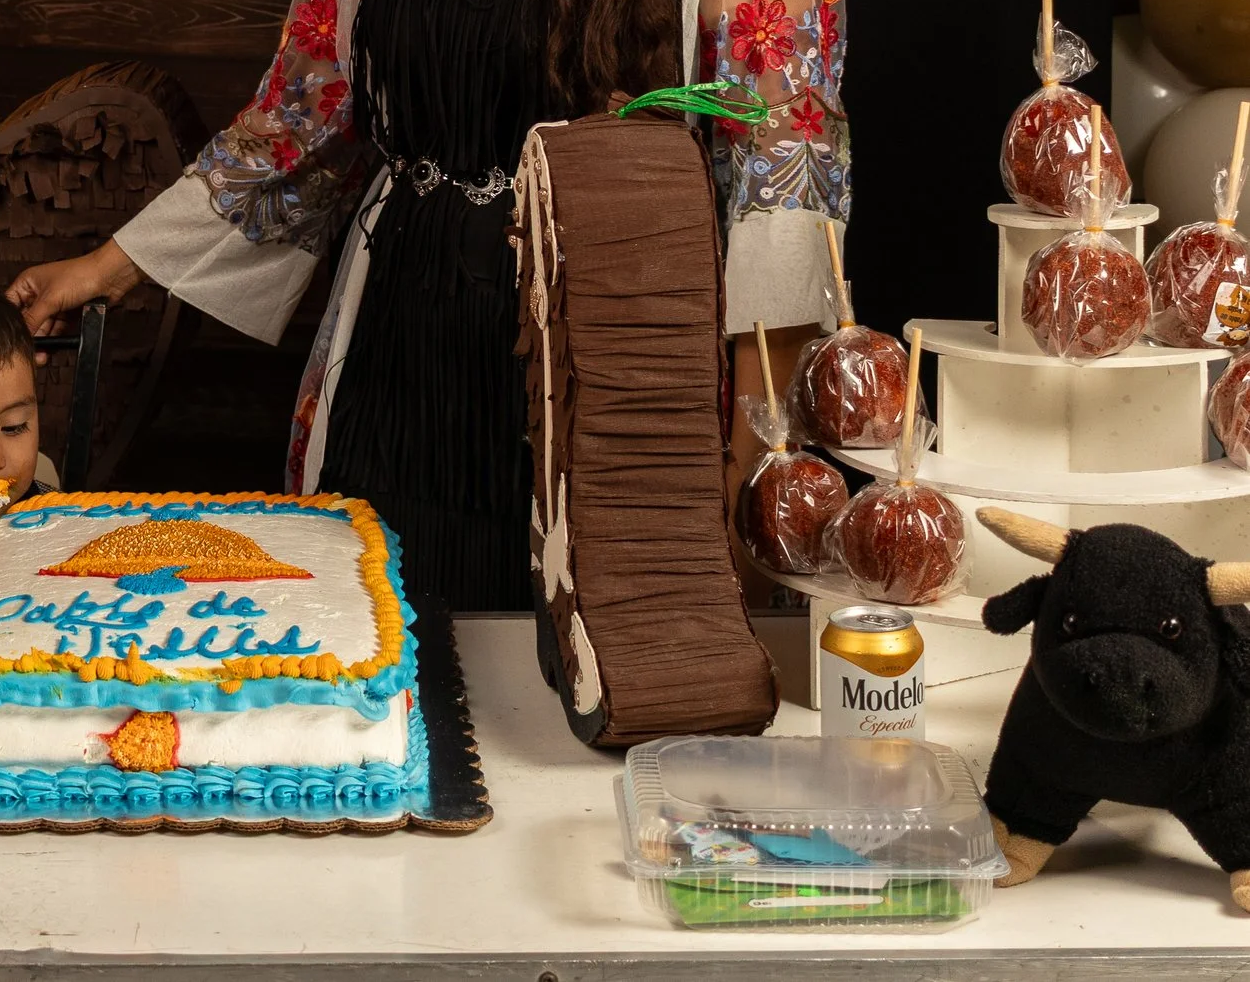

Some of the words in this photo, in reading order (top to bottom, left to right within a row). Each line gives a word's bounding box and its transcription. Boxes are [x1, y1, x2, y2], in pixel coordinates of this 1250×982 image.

[188, 590, 267, 617] de
[841, 676, 924, 711] Modelo
[859, 713, 917, 736] Especial
